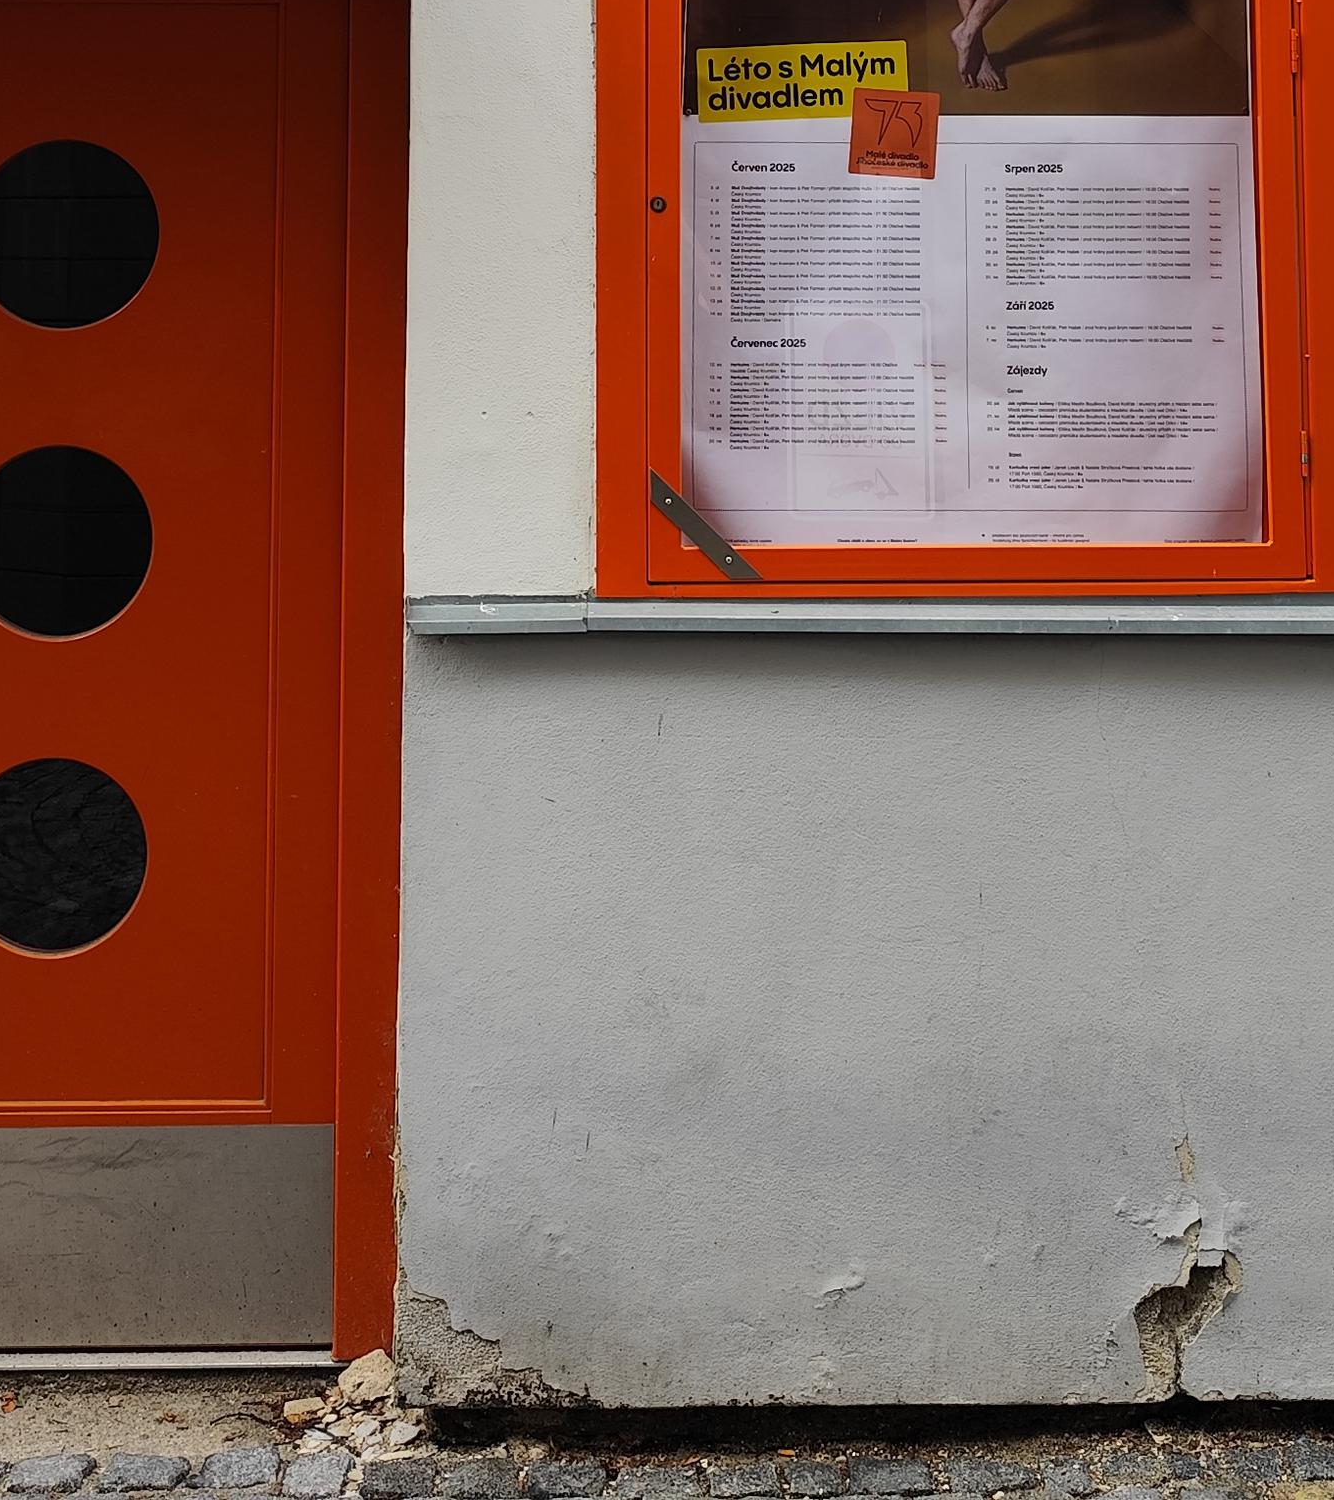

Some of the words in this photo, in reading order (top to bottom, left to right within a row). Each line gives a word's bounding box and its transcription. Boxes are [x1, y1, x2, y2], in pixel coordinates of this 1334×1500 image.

[708, 57, 772, 82] Léto
[778, 61, 793, 78] s
[800, 51, 895, 83] Malým
[708, 83, 844, 111] divadlem
[865, 150, 886, 159] Malé
[887, 151, 920, 161] divadlo
[731, 160, 768, 173] Červen
[769, 162, 796, 173] 2025
[897, 159, 929, 170] divadlo
[1004, 164, 1036, 178] Srpen
[1037, 164, 1064, 175] 2025
[1006, 299, 1027, 311] Září
[1028, 300, 1055, 311] 2025
[730, 335, 779, 349] Červenec
[780, 337, 807, 349] 2025
[1006, 364, 1048, 378] Zájezdy
